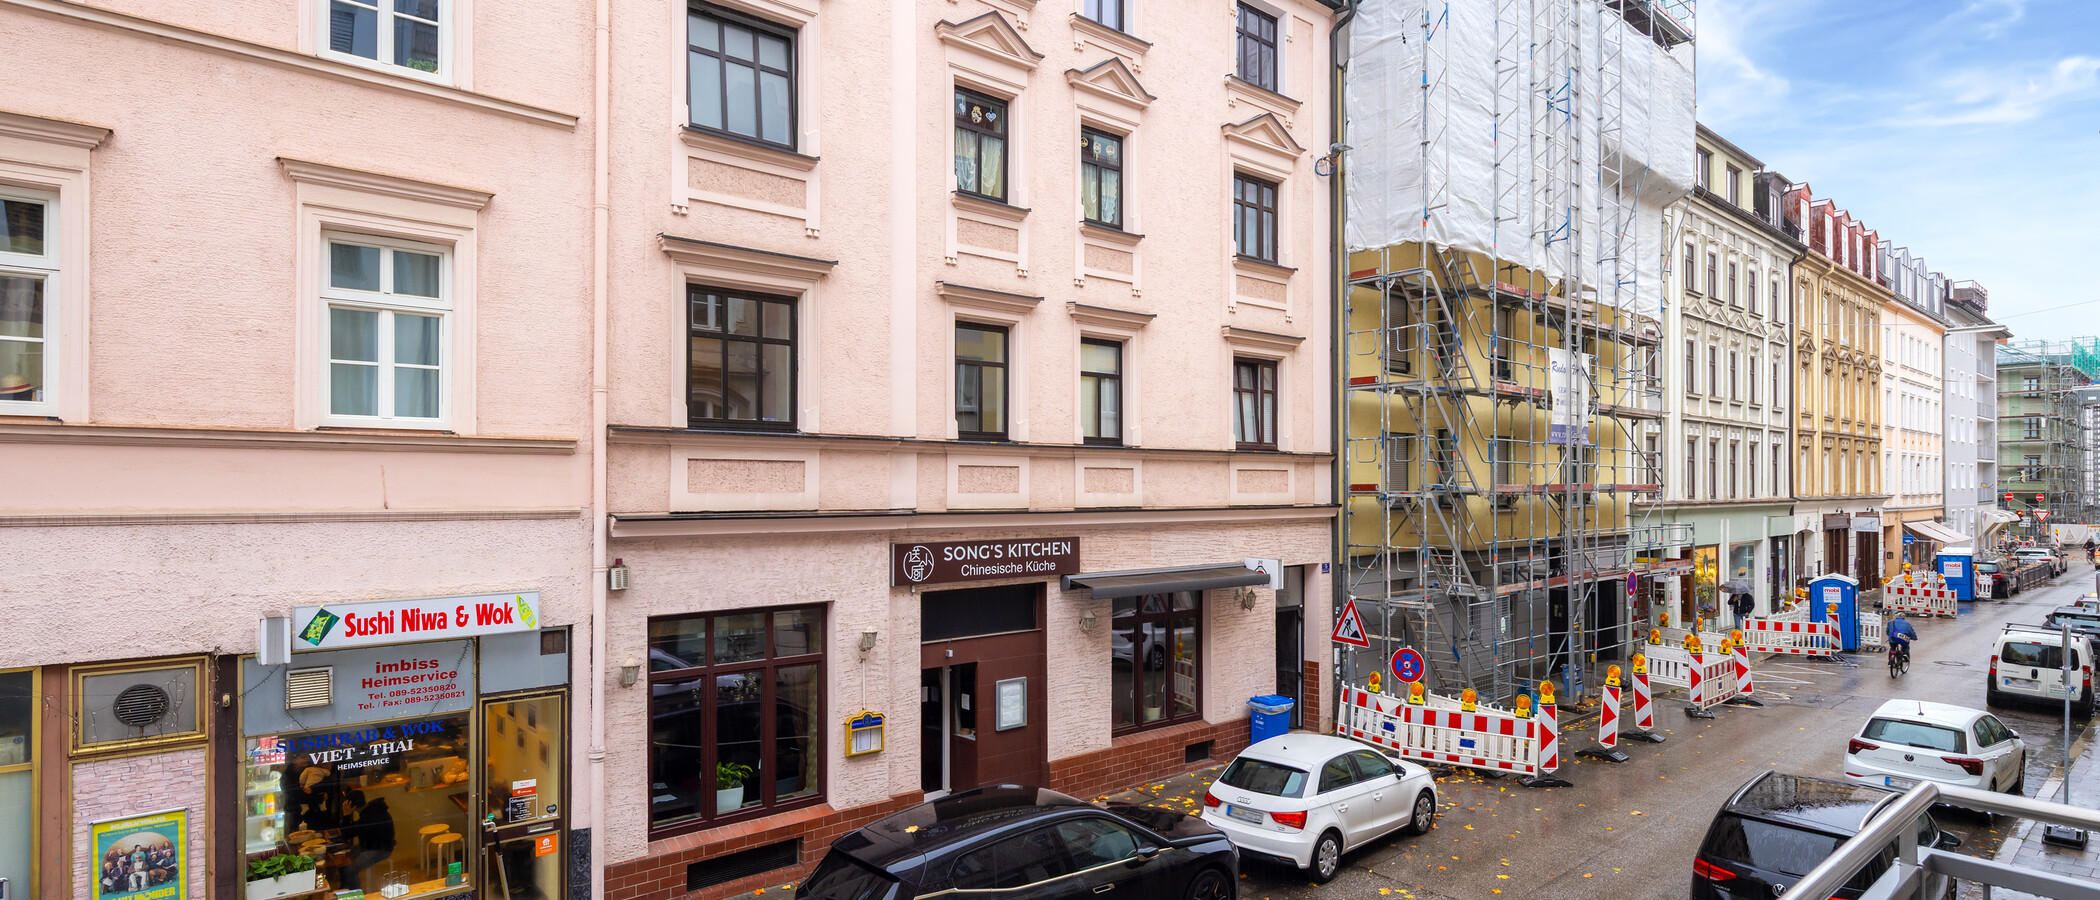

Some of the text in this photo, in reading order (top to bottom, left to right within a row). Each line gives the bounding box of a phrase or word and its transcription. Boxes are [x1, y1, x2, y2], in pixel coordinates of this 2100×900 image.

[943, 541, 1071, 562] SONG'S KITCHEN
[961, 559, 1056, 577] Chinesische Küche
[345, 602, 514, 638] Sushi Niwa & Wok
[375, 658, 440, 674] imbiss
[362, 670, 458, 689] Heimservice
[358, 702, 375, 710] Tel.
[383, 699, 402, 707] Fax:
[405, 690, 465, 704] 089-52350821
[368, 683, 457, 700] Tel. 089-52350820
[276, 719, 445, 754] SUSHIBAR & WOK
[309, 747, 356, 765] VIET
[369, 738, 414, 756] THAI
[337, 757, 390, 771] HEIMSERVICE
